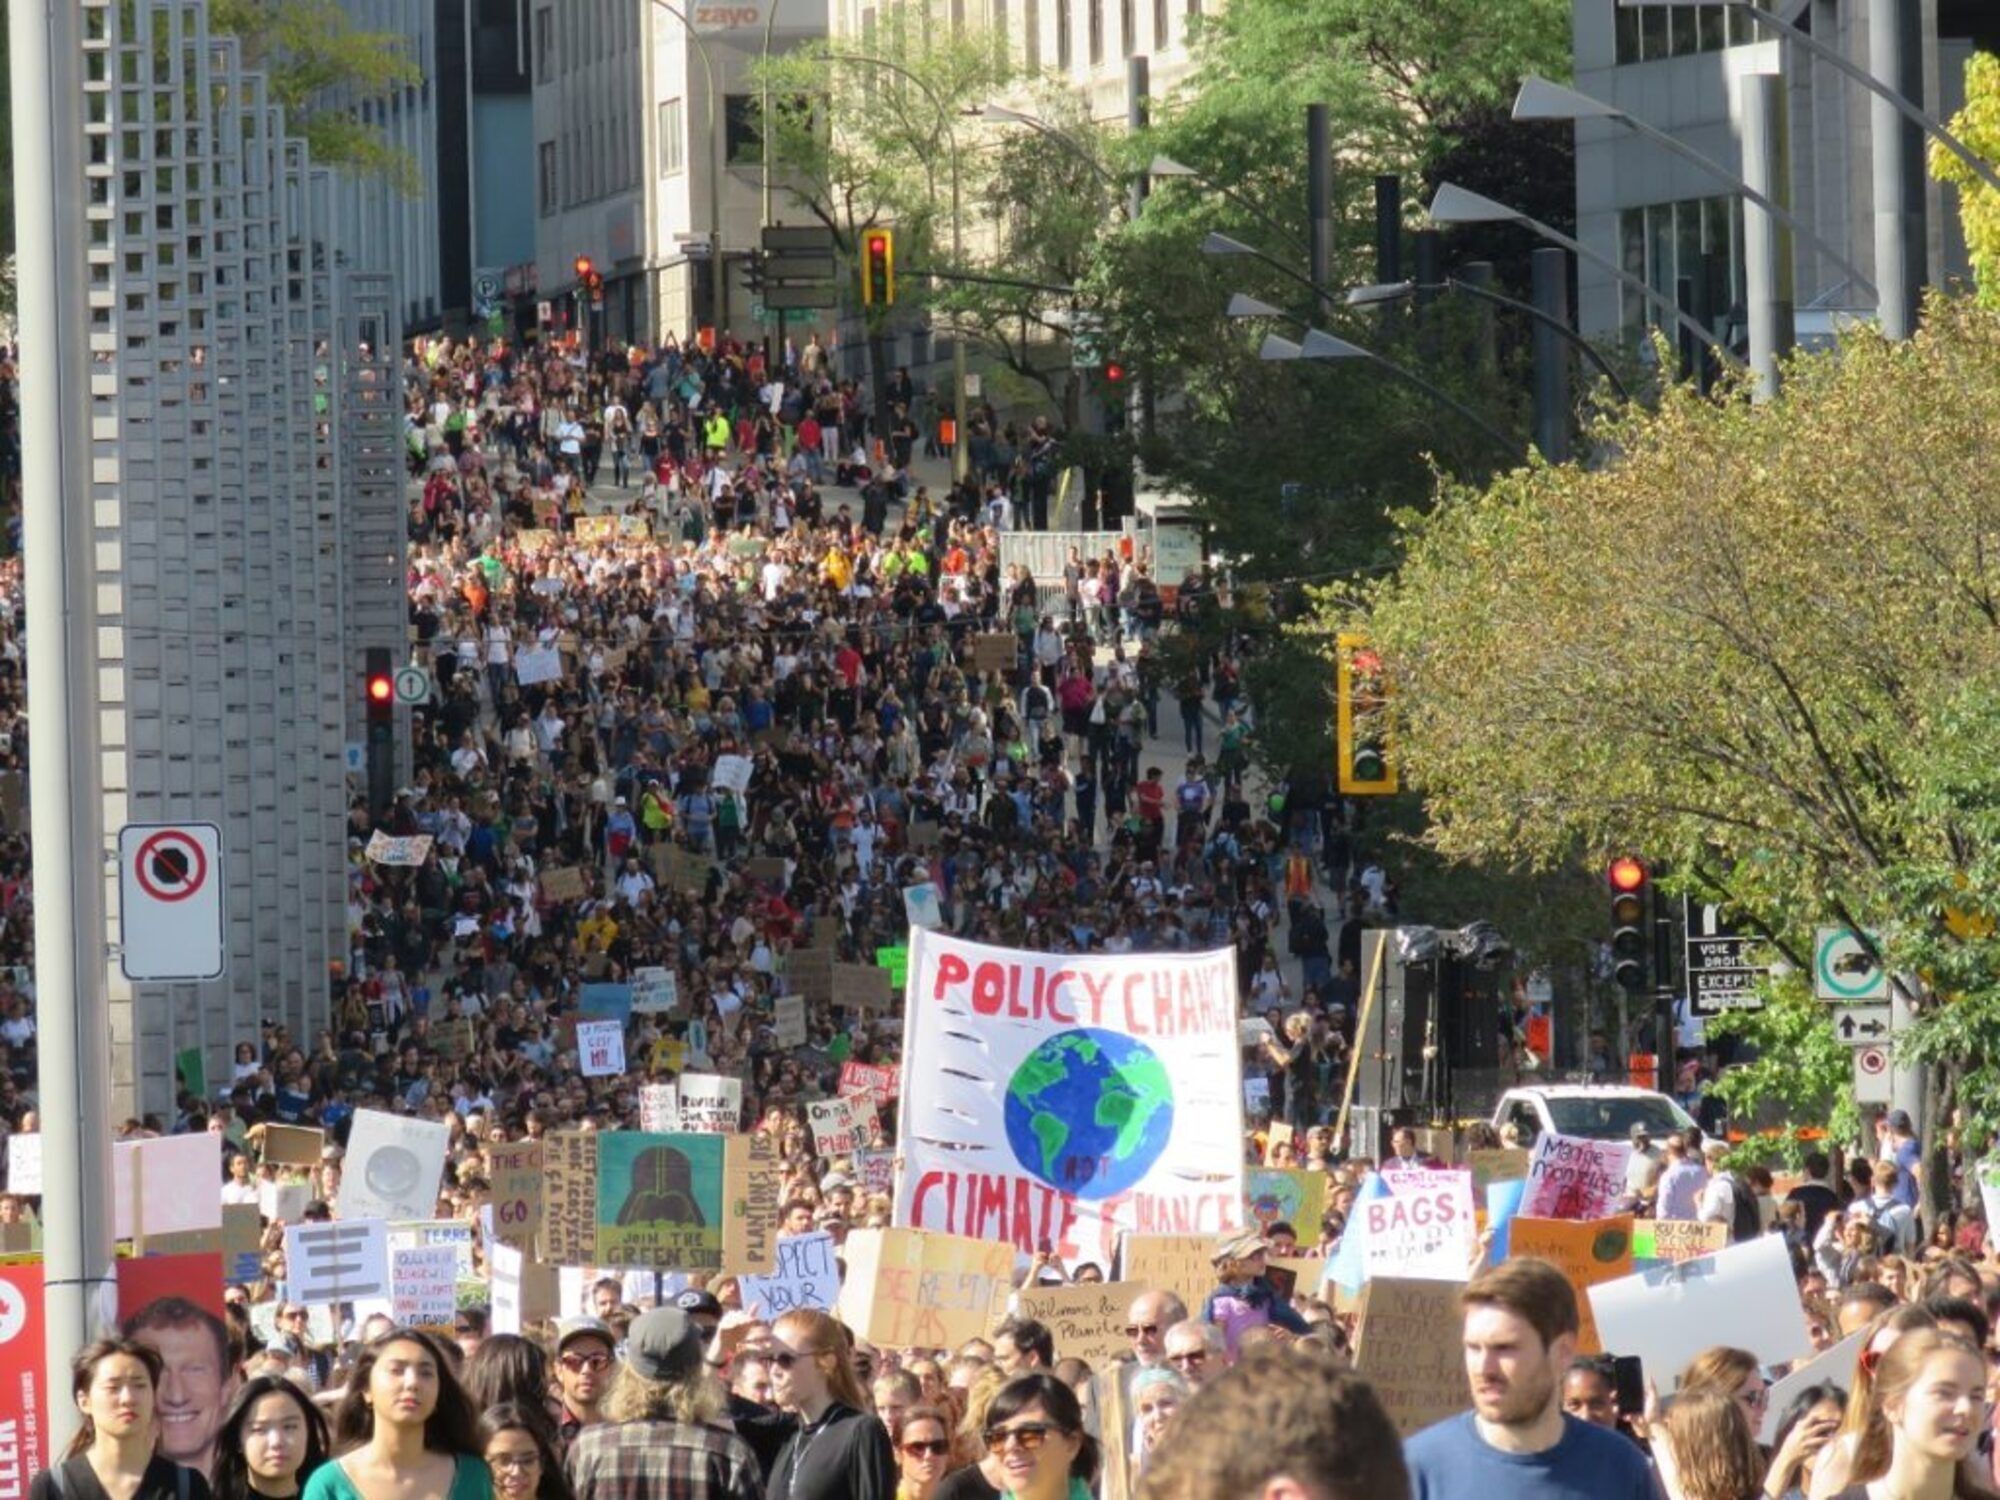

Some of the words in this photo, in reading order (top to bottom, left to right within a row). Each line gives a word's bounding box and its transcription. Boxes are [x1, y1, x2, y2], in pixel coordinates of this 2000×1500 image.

[696, 8, 759, 30] zayo
[1700, 943, 1729, 955] VOIE
[933, 953, 1113, 1024] POLICY
[811, 1105, 831, 1120] On
[492, 1154, 521, 1170] THE
[1542, 1136, 1605, 1169] Mange
[1064, 1156, 1110, 1182] NOT
[500, 1199, 529, 1225] GO
[747, 1171, 769, 1262] PLANTONS
[910, 1171, 1080, 1260] CLIMATE
[1368, 1193, 1456, 1234] BAGS
[622, 1232, 659, 1245] JOIN
[671, 1232, 704, 1247] THE
[606, 1246, 682, 1266] GREEN
[759, 1282, 824, 1313] YOUR
[1099, 1295, 1121, 1317] la
